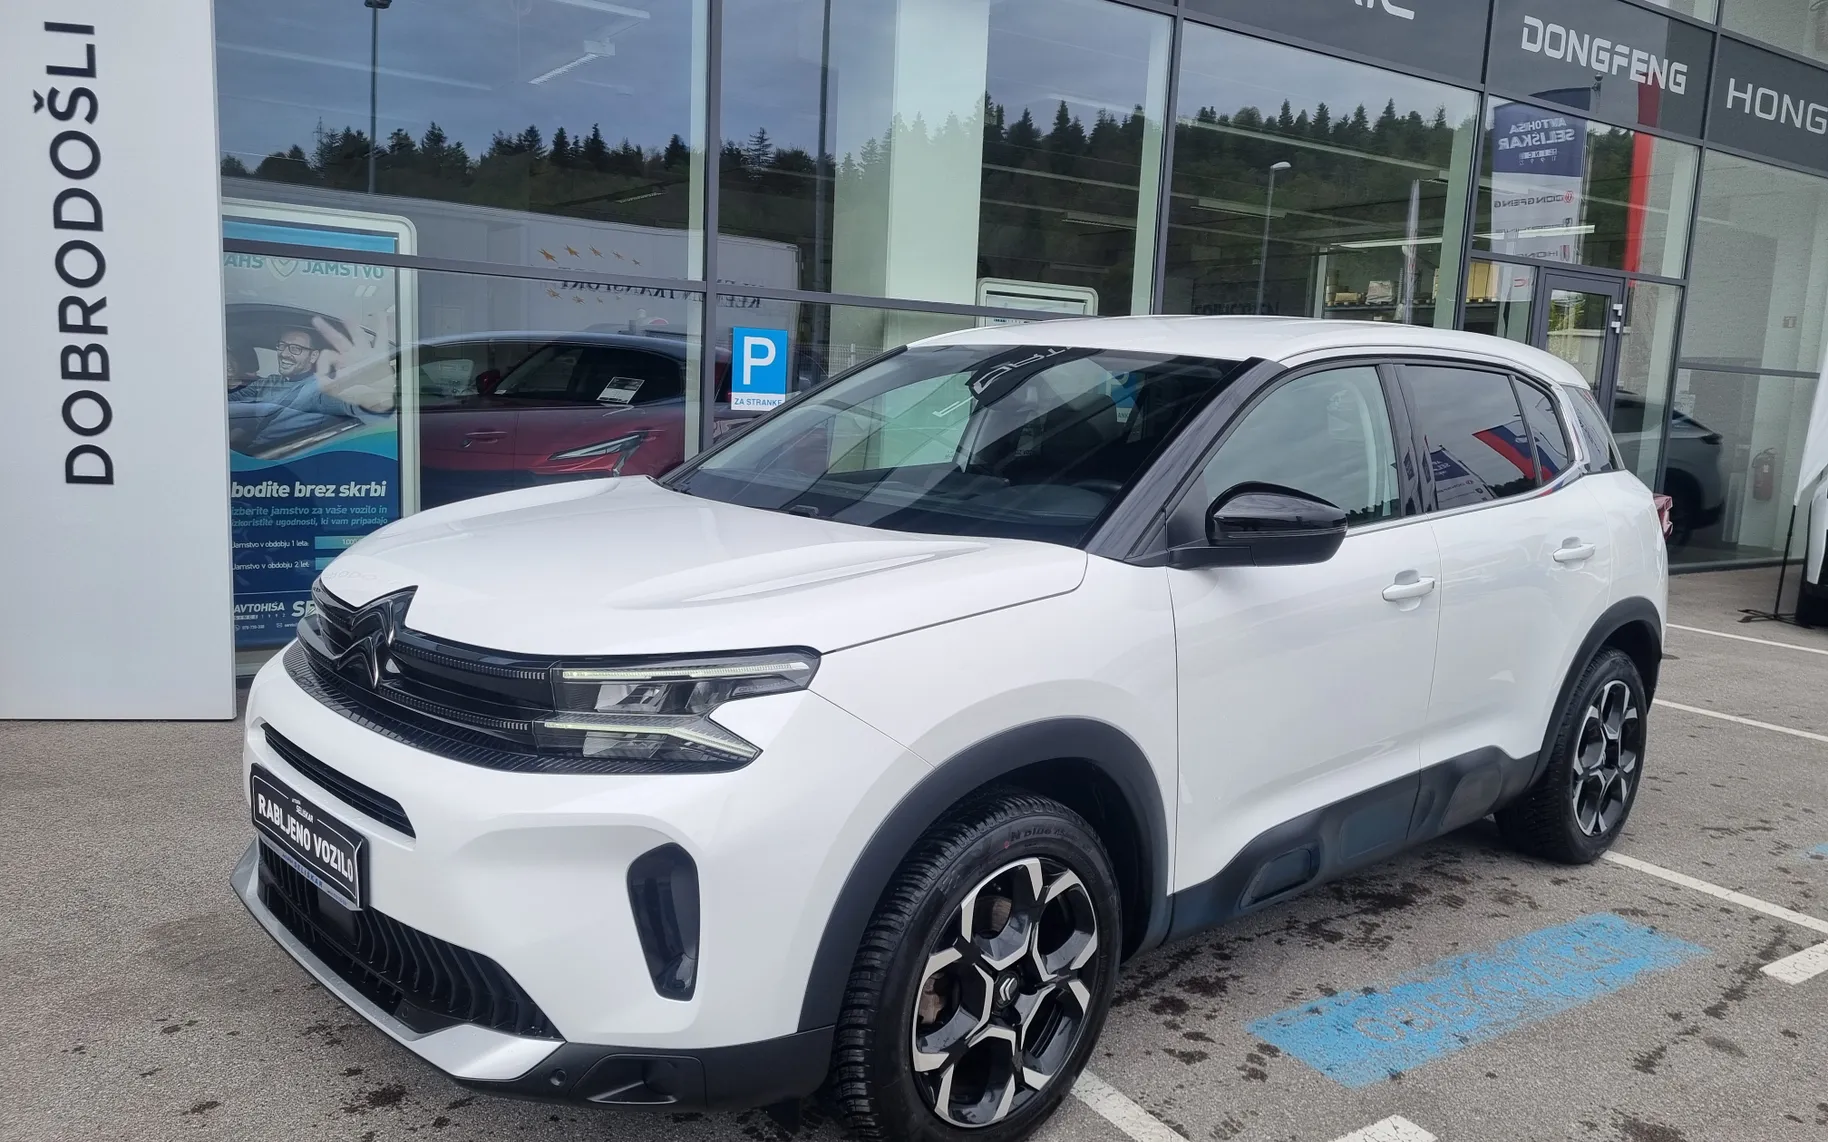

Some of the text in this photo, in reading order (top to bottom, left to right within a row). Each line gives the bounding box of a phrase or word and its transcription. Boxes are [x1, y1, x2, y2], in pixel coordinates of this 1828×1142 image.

[1522, 15, 1688, 95] DONGFENG
[1726, 77, 1828, 135] HONG
[33, 22, 114, 485] DOBRODOŠLI
[302, 261, 384, 279] JAMSTVO
[743, 336, 776, 385] P
[231, 480, 387, 498] bodite brez skrbi
[231, 503, 388, 517] izberite jamstvo za vaše vozilo in
[275, 518, 318, 529] ugodnosti,
[320, 517, 329, 525] ki
[351, 517, 388, 527] pripadajo
[265, 540, 291, 549] obdobju
[267, 561, 293, 570] obdobju
[234, 602, 286, 614] AVTOHIŠA
[257, 793, 354, 883] RABLJENO VOZILO
